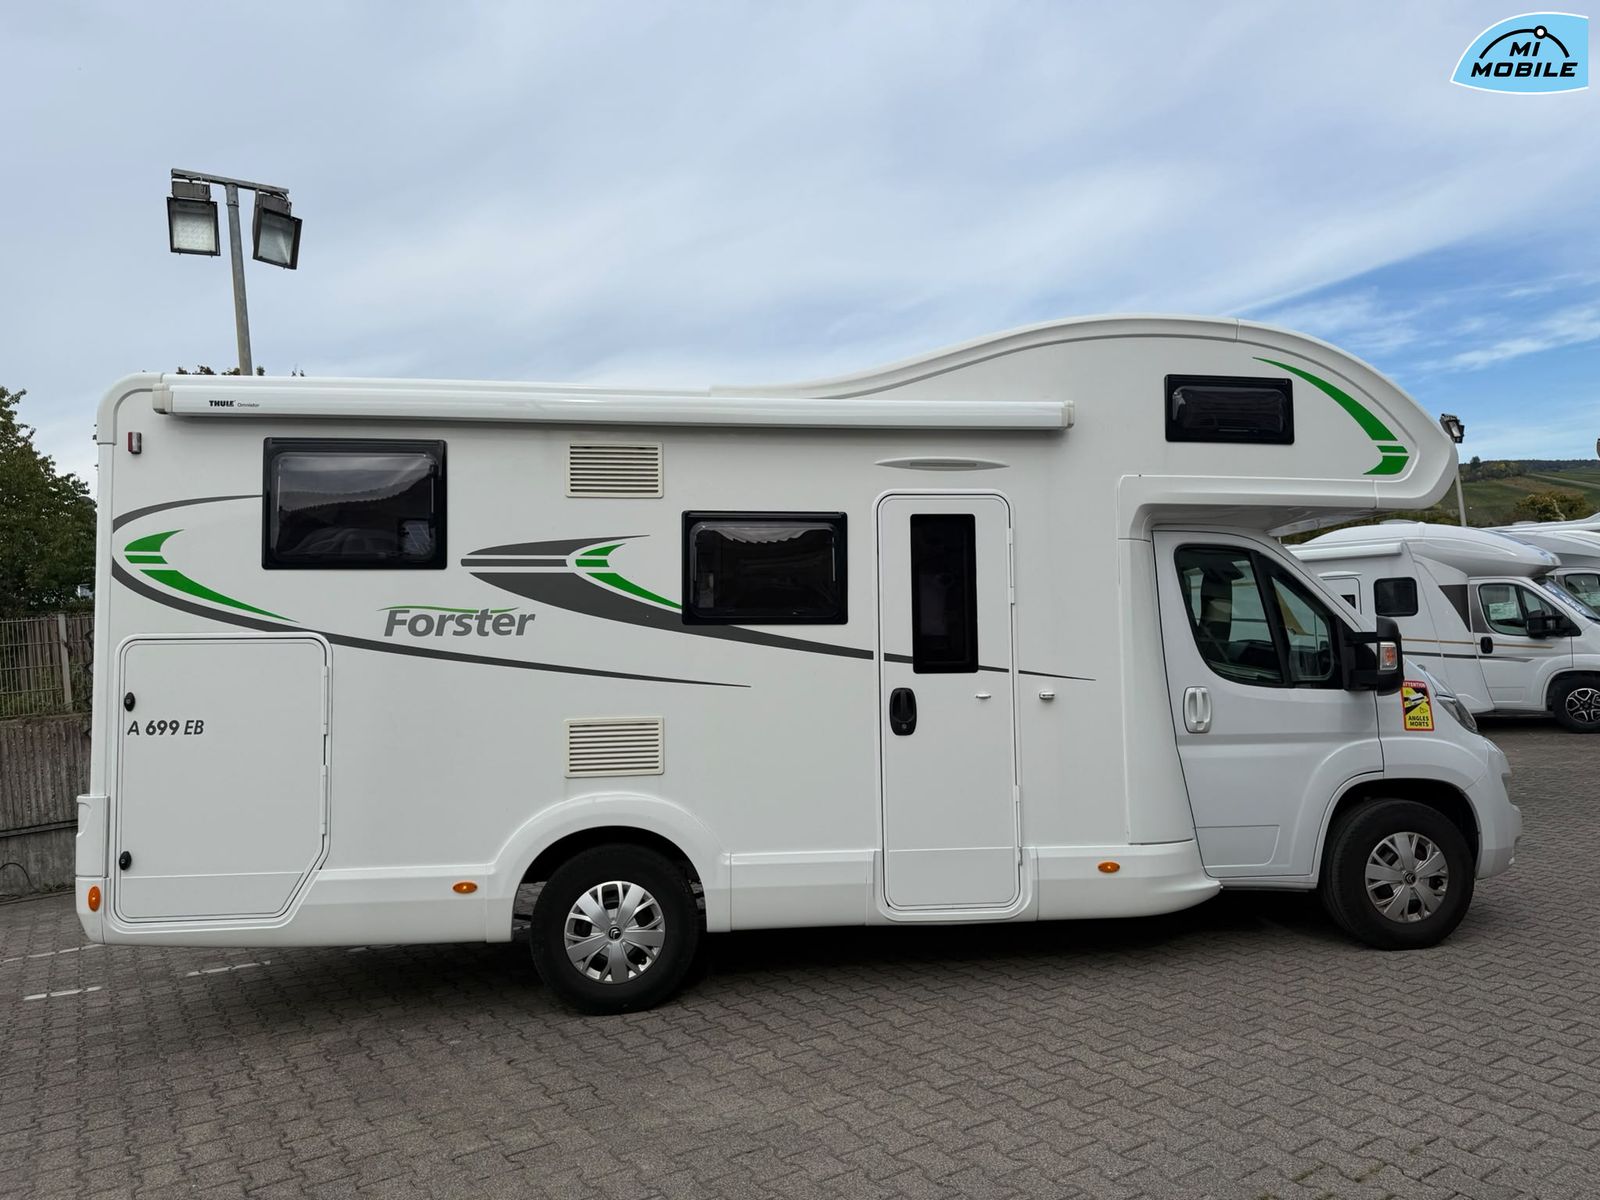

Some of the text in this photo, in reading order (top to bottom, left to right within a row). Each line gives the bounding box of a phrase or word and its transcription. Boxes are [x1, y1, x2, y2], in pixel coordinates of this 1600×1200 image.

[384, 608, 535, 637] Forster
[127, 720, 204, 735] A 699 EB
